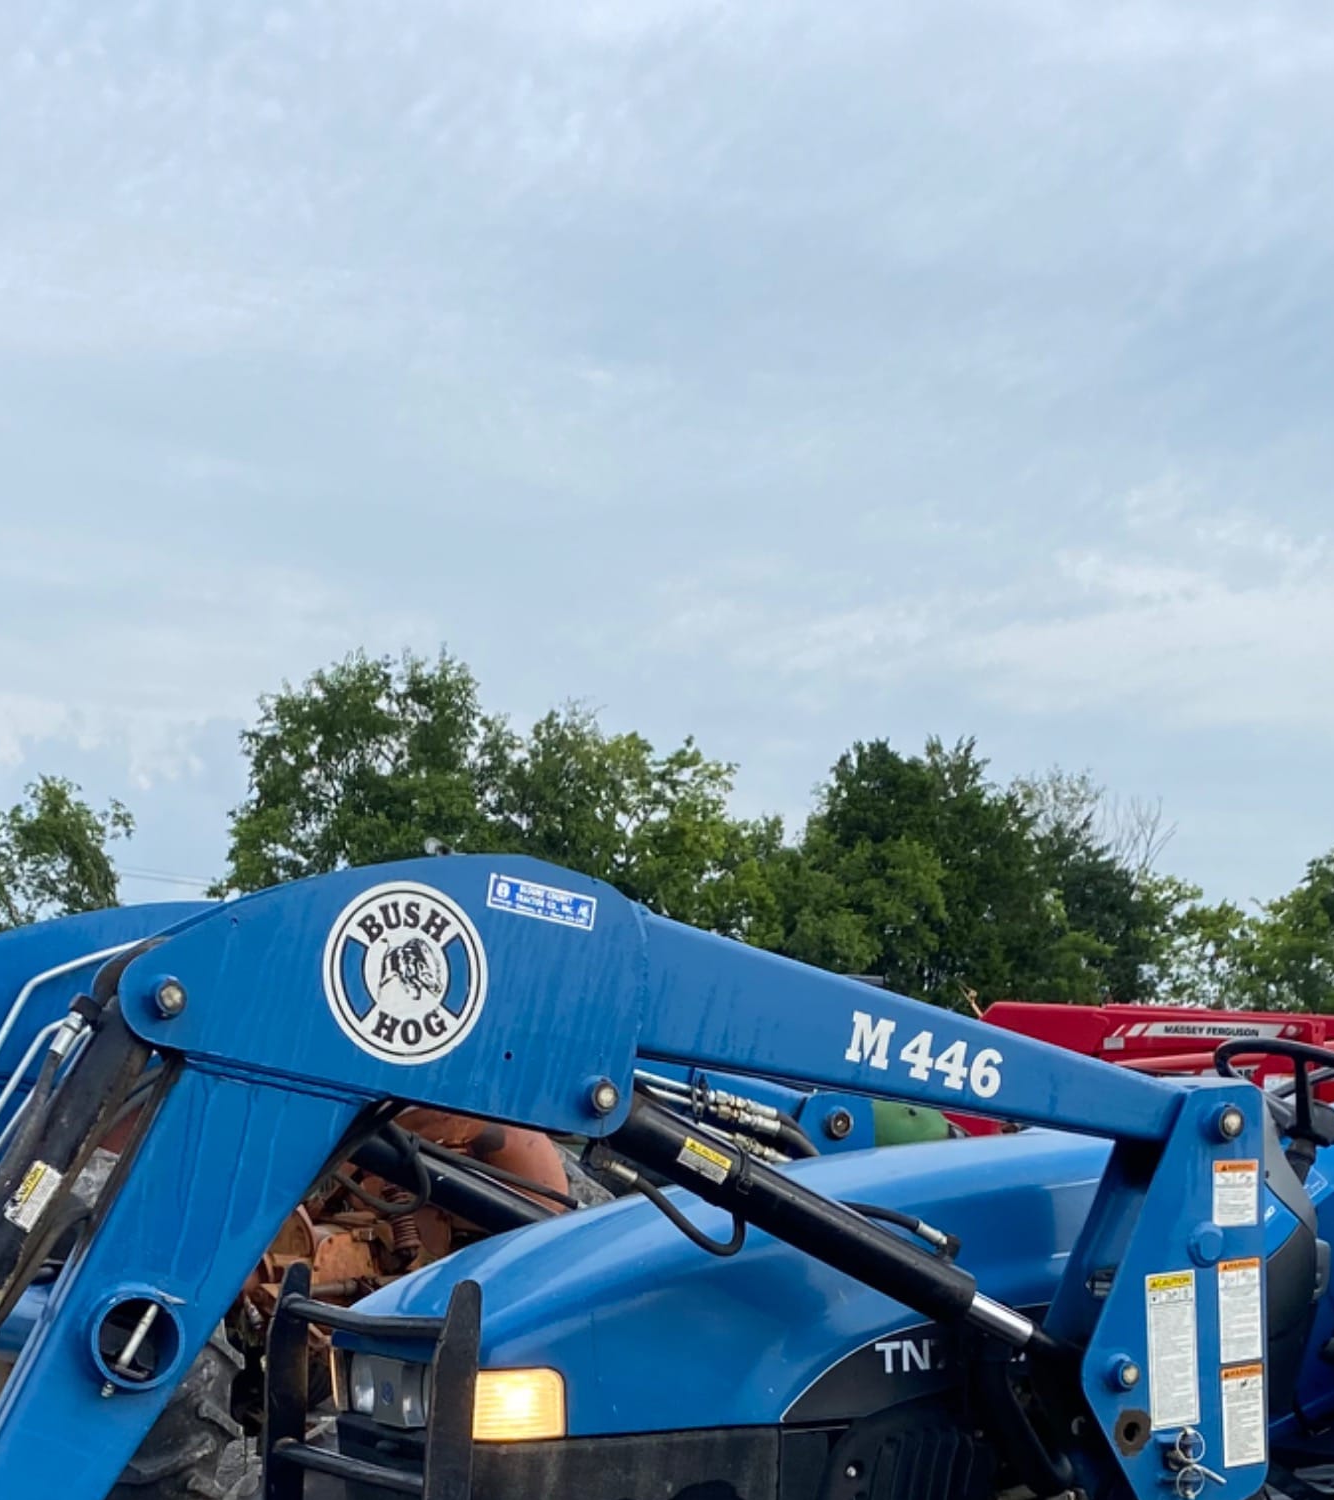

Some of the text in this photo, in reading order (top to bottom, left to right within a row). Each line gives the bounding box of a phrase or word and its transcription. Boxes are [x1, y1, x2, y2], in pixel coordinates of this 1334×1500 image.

[356, 901, 452, 943] BUSH
[371, 1010, 448, 1046] HOG
[1164, 1024, 1260, 1037] MASSEY FERGUSON
